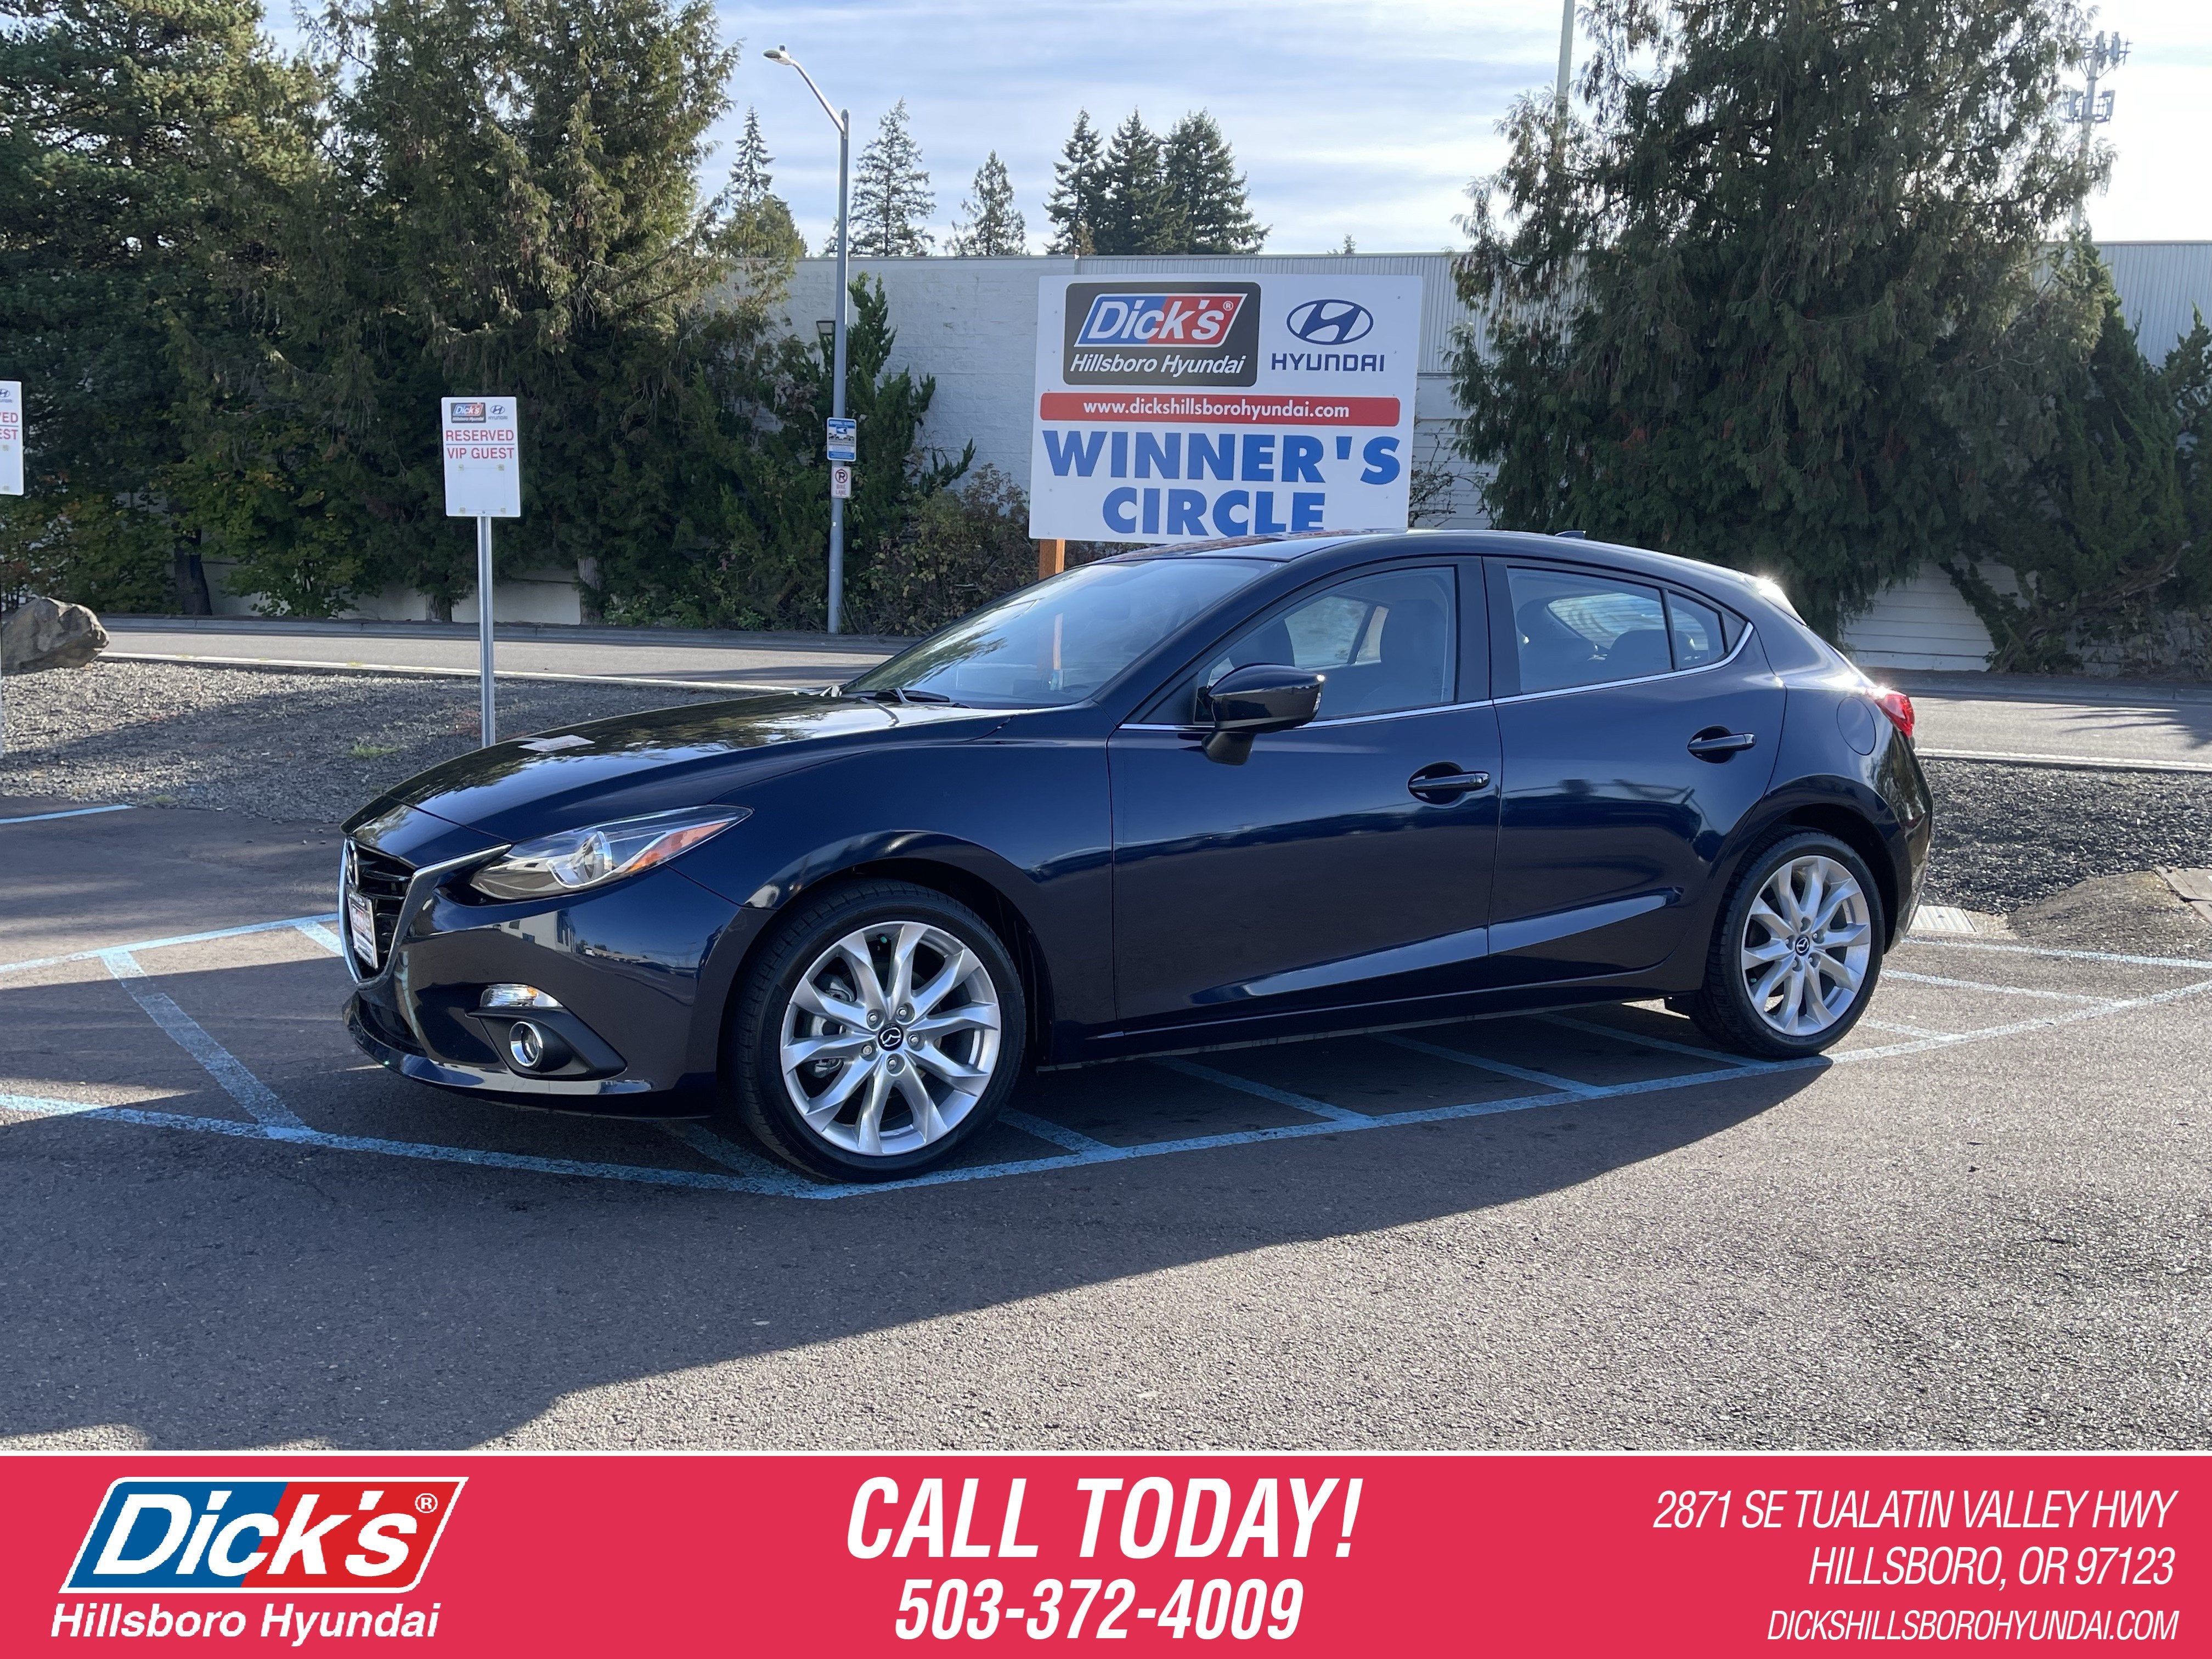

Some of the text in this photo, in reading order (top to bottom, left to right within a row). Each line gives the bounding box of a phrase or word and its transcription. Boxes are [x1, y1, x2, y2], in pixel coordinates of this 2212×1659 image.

[1070, 354, 1247, 378] Hillsboro Hyundai
[1272, 353, 1385, 372] HYUNDAI
[1084, 398, 1349, 421] www.dickshillsborohyundai.com
[445, 430, 515, 441] RESERVED
[447, 448, 515, 459] VIP GUEST
[1042, 430, 1401, 485] WINNER'S
[1102, 487, 1326, 536] CIRCLE
